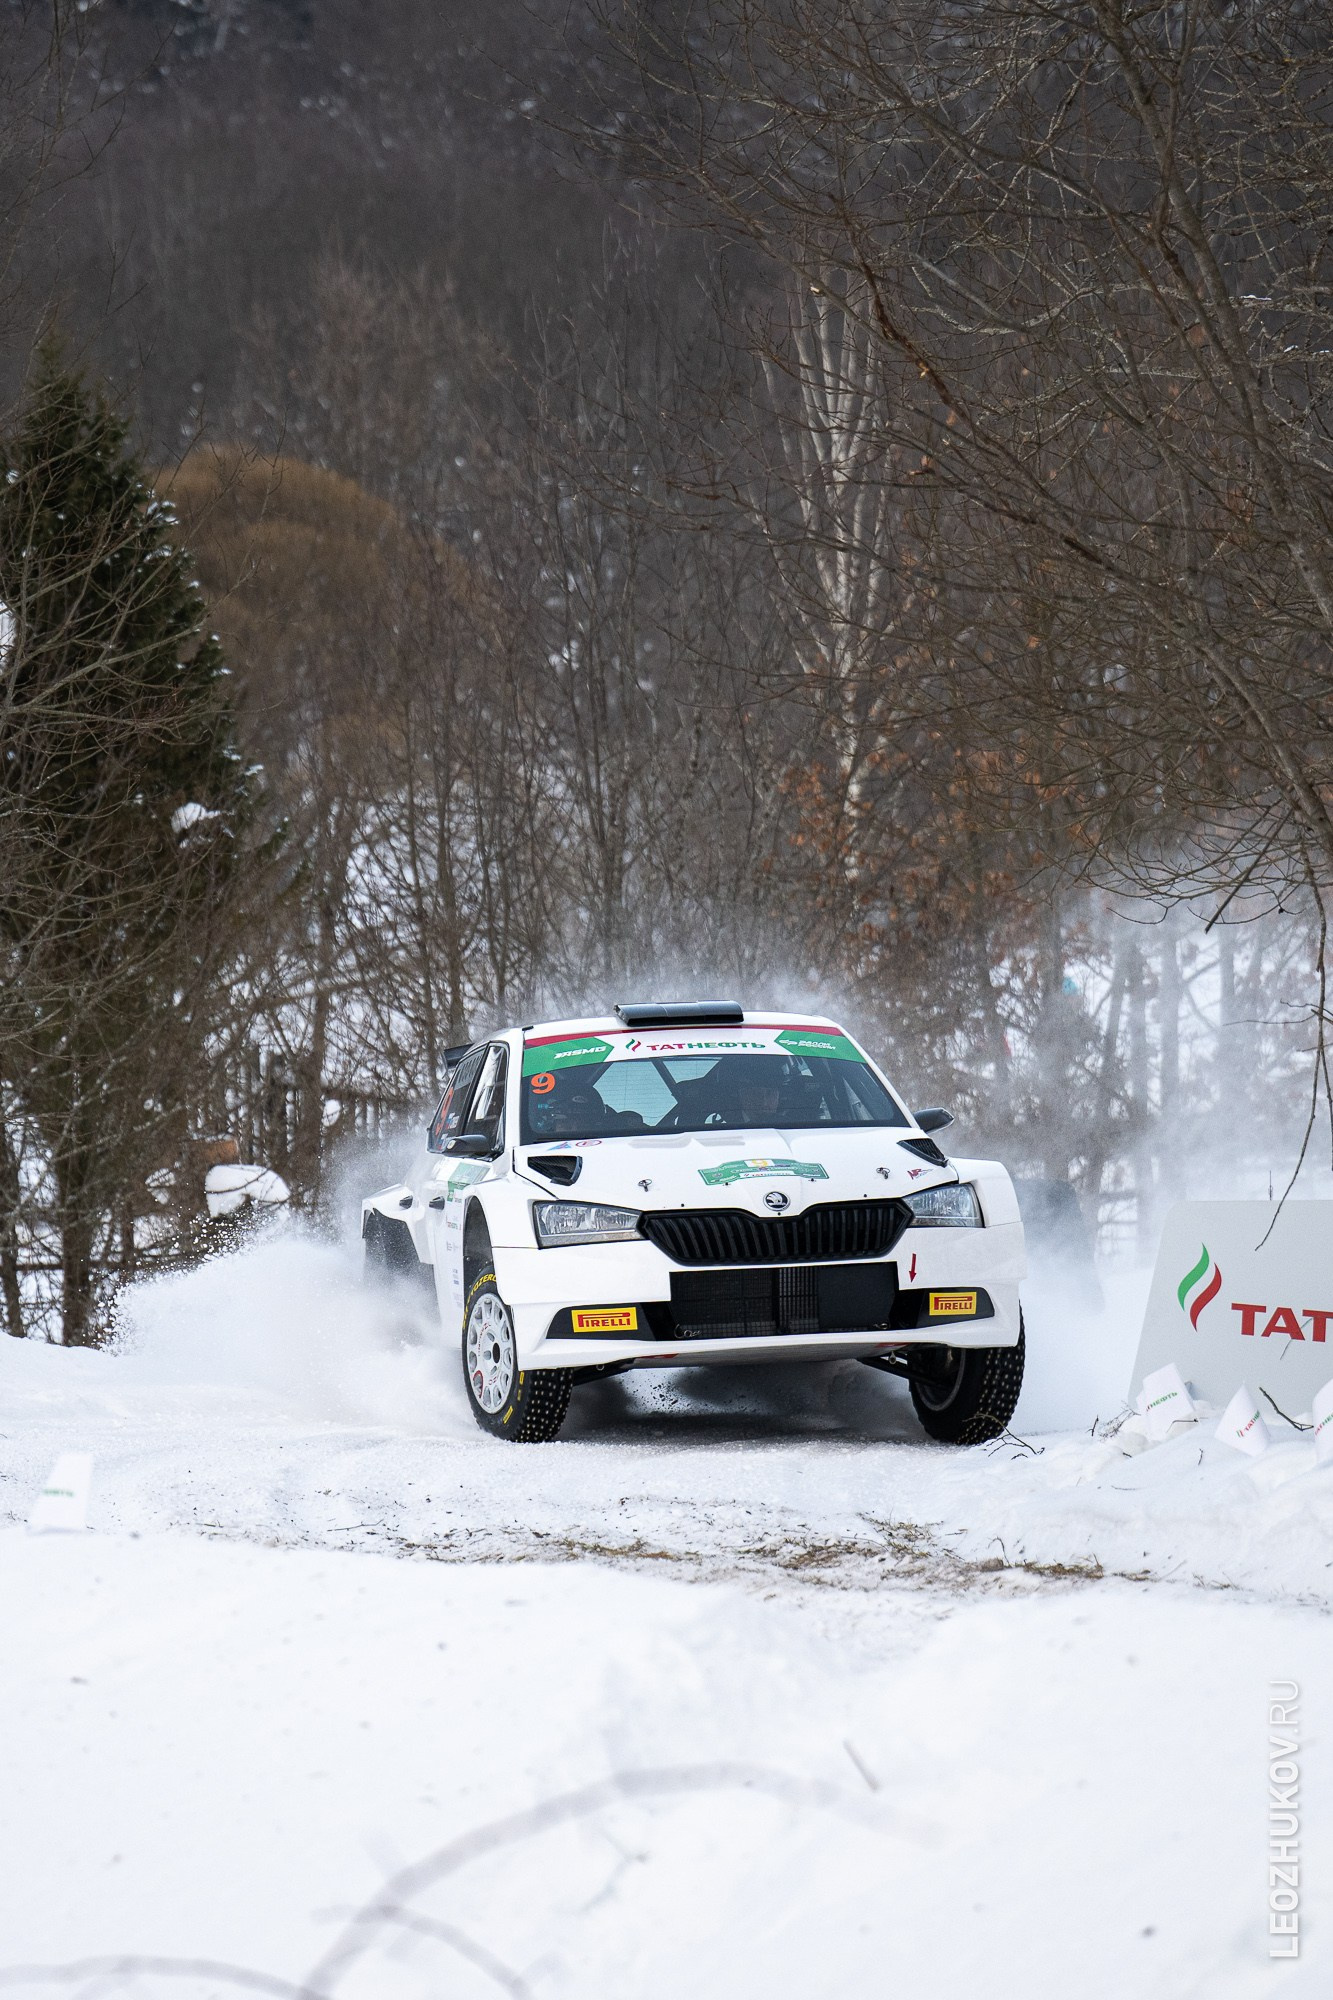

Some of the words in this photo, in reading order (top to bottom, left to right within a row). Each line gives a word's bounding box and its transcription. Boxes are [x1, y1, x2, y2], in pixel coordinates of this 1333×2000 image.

[646, 1042, 766, 1051] ТАТНЕФТЬ
[531, 1073, 556, 1094] 9
[933, 1296, 973, 1310] PIRELLI
[577, 1312, 631, 1328] PIRELLI
[1231, 1302, 1333, 1343] ТАТ
